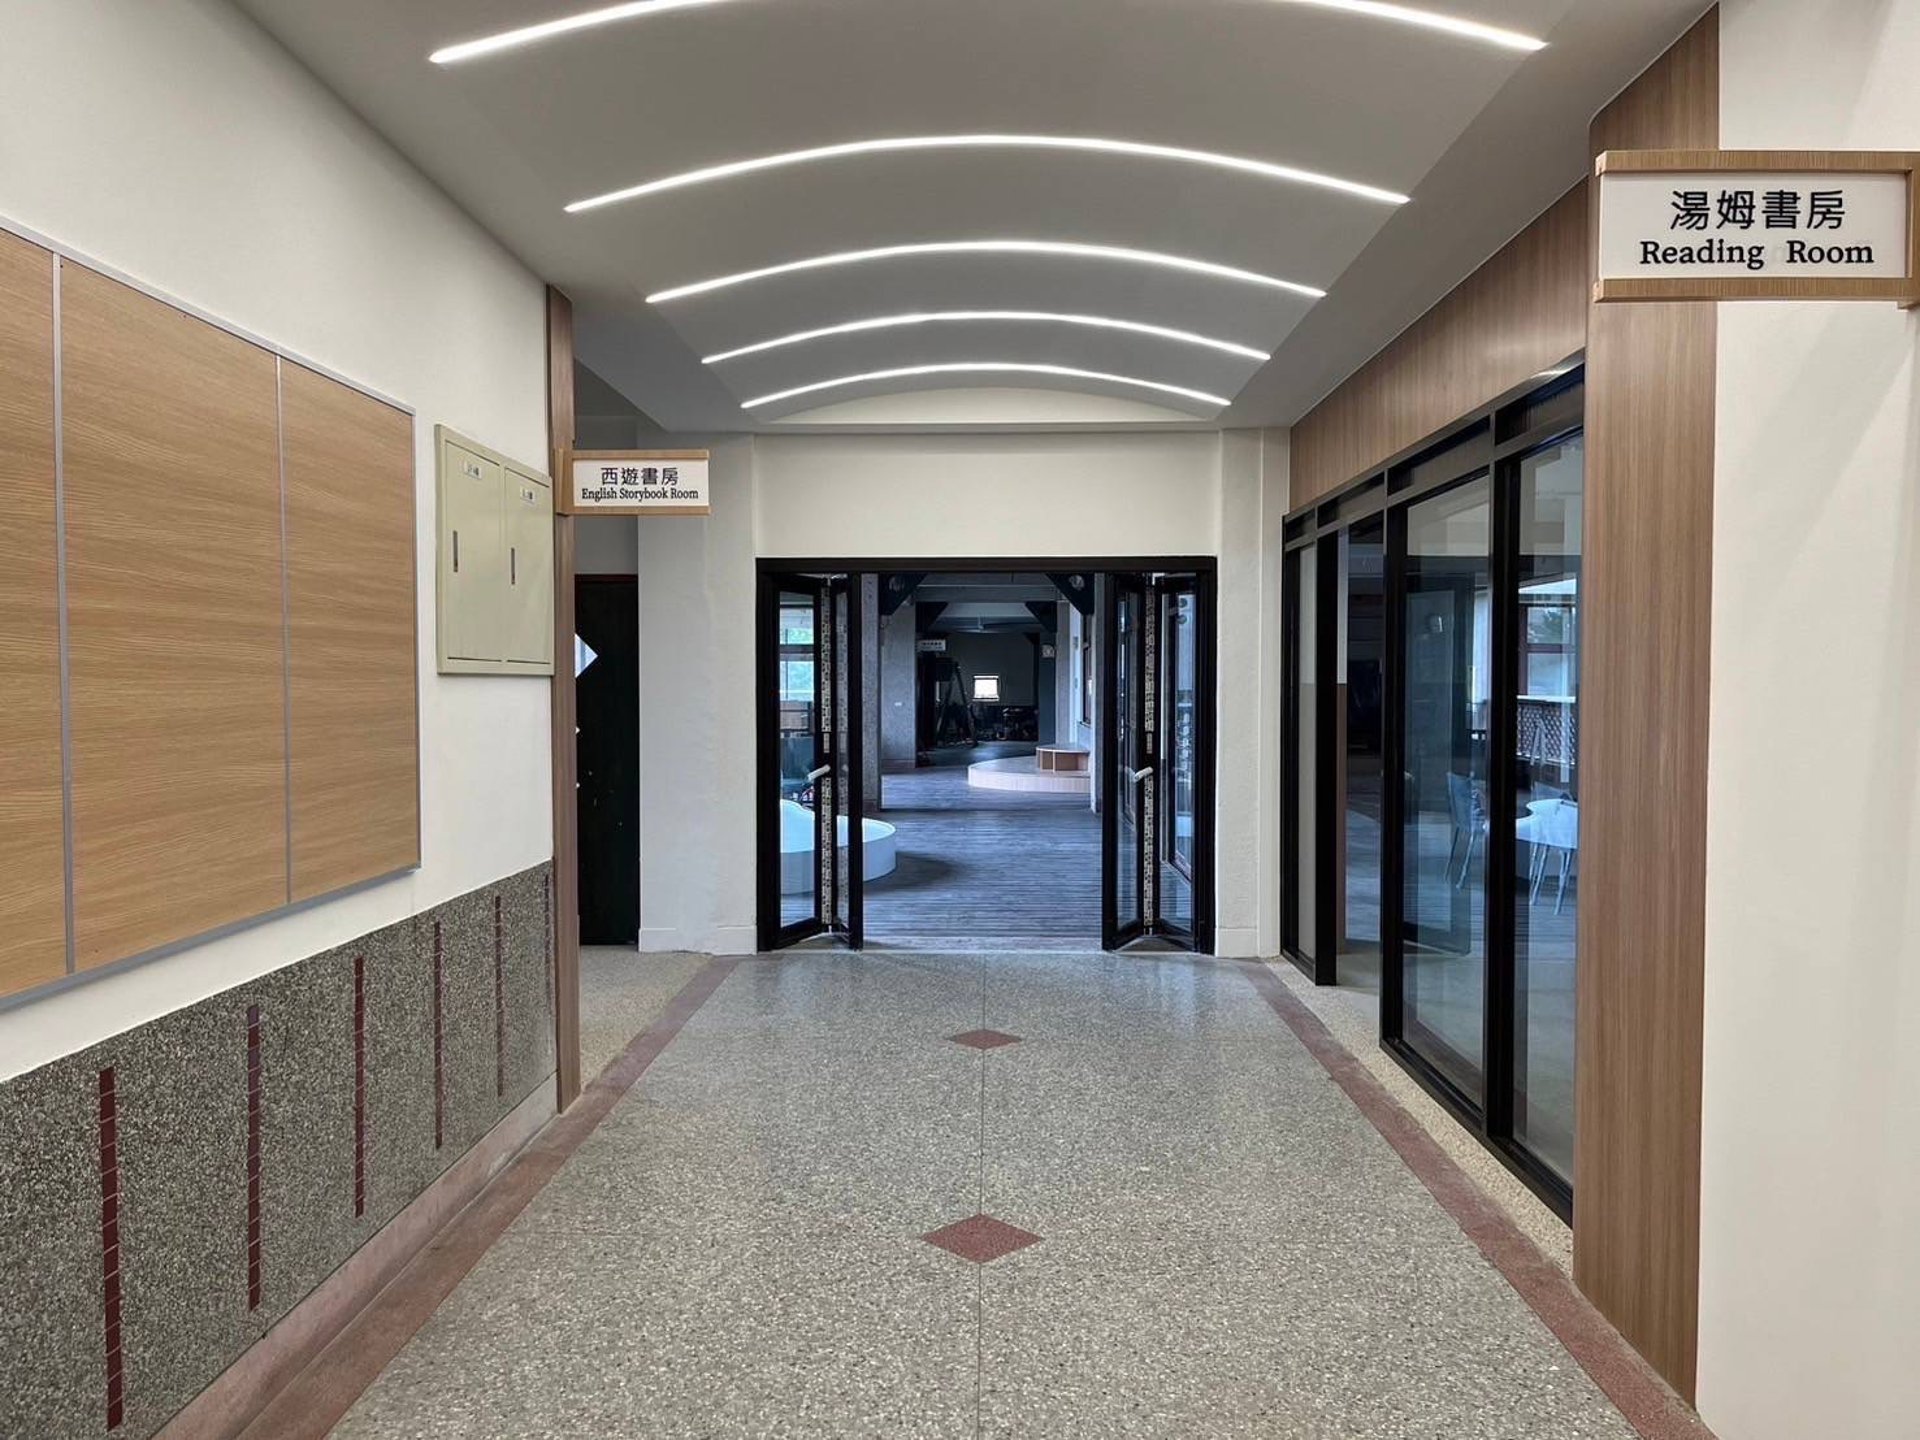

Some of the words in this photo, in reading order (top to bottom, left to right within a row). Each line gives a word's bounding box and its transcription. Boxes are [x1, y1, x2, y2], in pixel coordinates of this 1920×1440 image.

[1670, 189, 1845, 230] 湯姆書房
[1640, 238, 1764, 270] Reading
[1786, 240, 1875, 264] Room
[600, 467, 679, 486] 西遊書房
[582, 488, 617, 502] English
[619, 487, 668, 502] Storybook
[670, 488, 699, 500] Room
